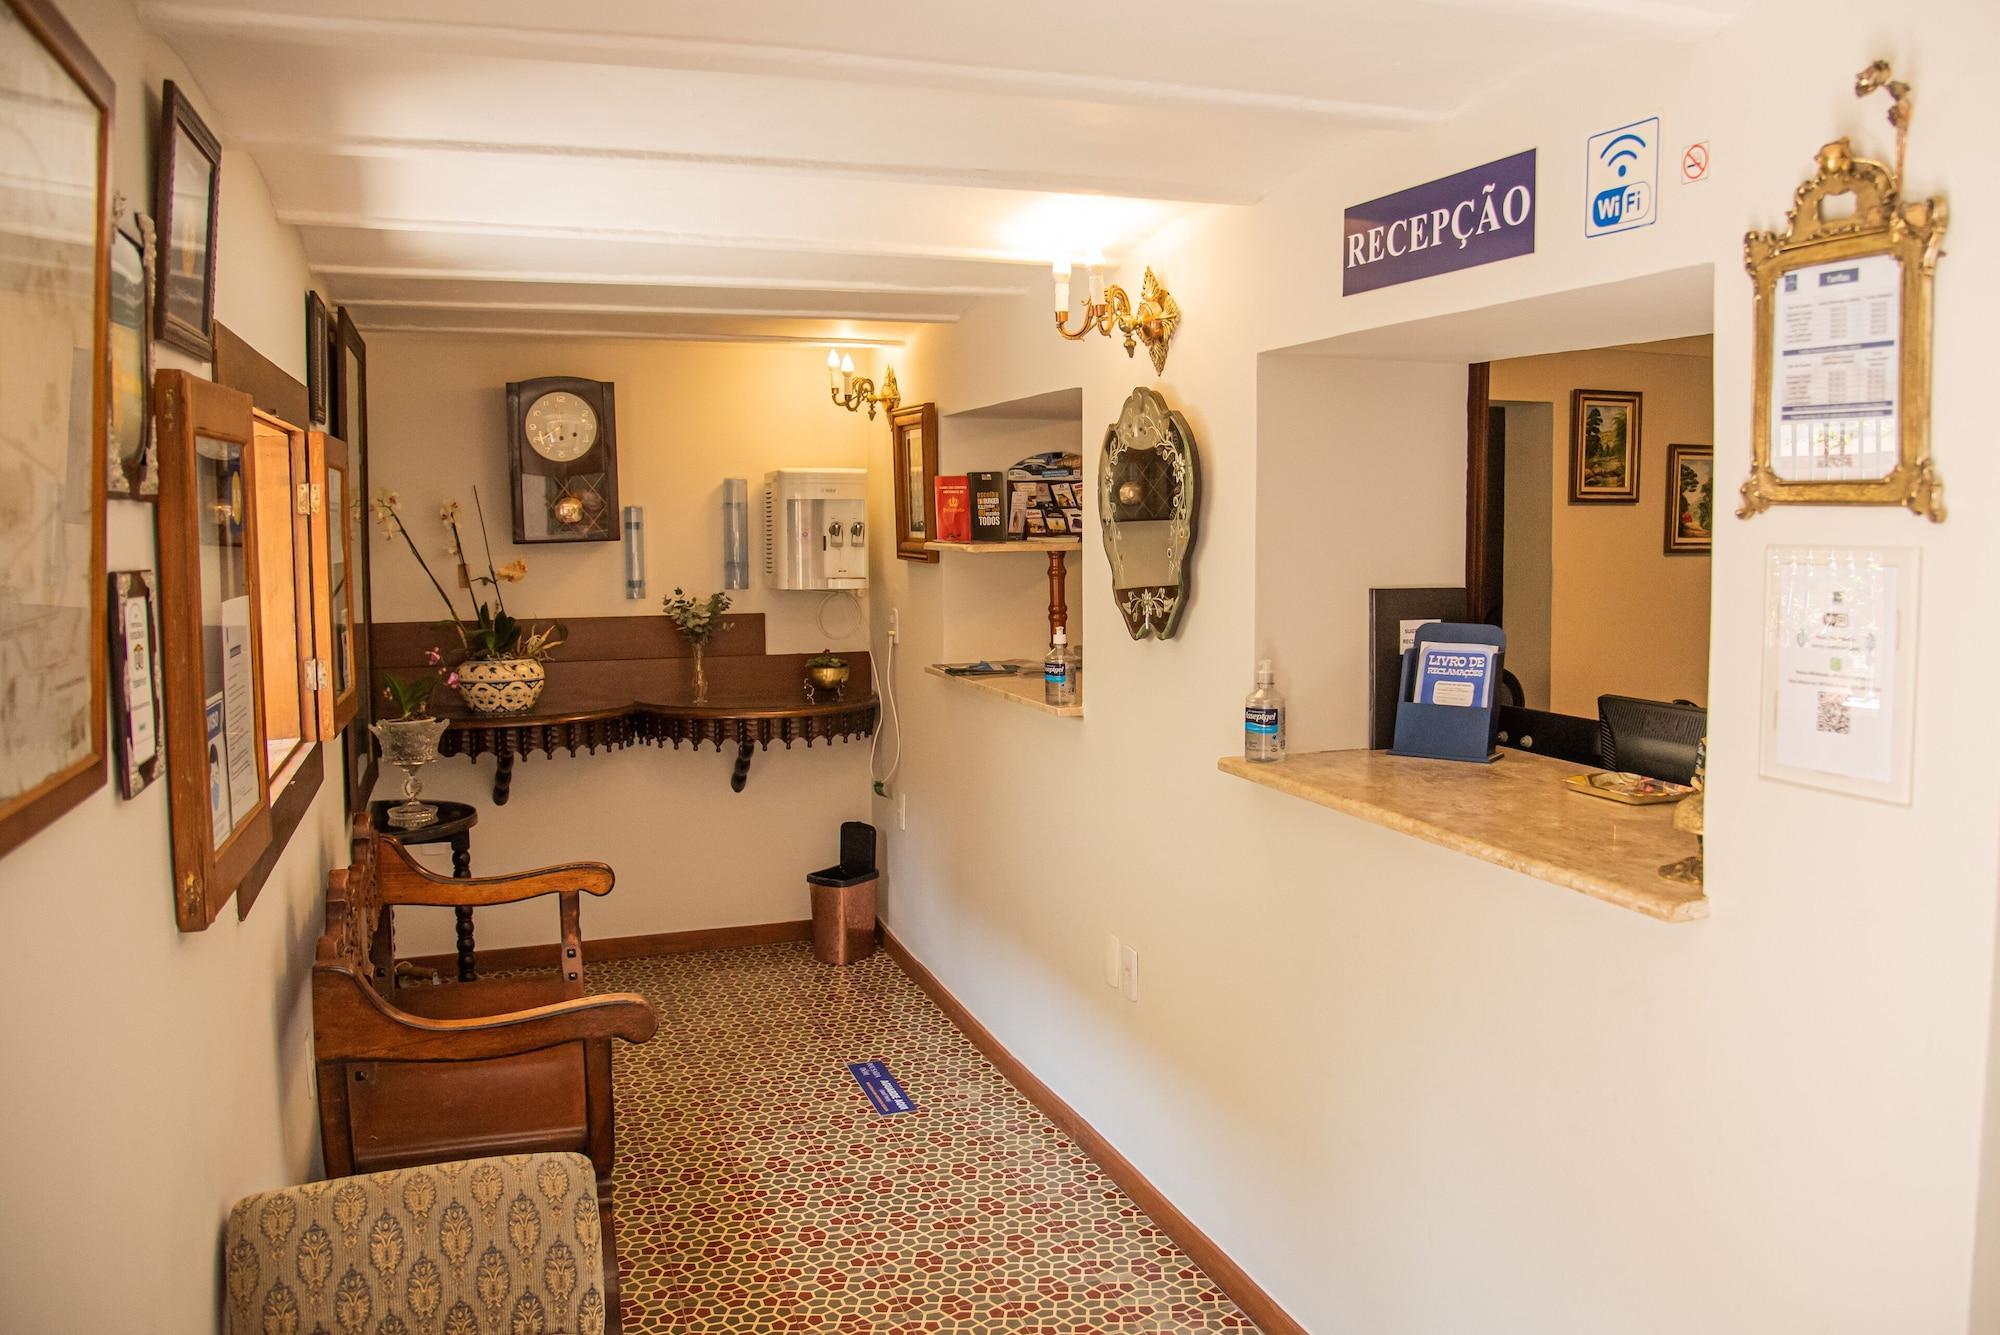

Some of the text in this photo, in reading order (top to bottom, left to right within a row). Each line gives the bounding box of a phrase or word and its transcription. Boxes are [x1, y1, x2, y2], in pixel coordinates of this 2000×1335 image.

[1346, 182, 1532, 270] RECEPÇÃO
[978, 516, 1001, 526] TODOS
[1428, 655, 1486, 668] LIVRO DE
[1426, 667, 1484, 678] RECLAMAÇÕES
